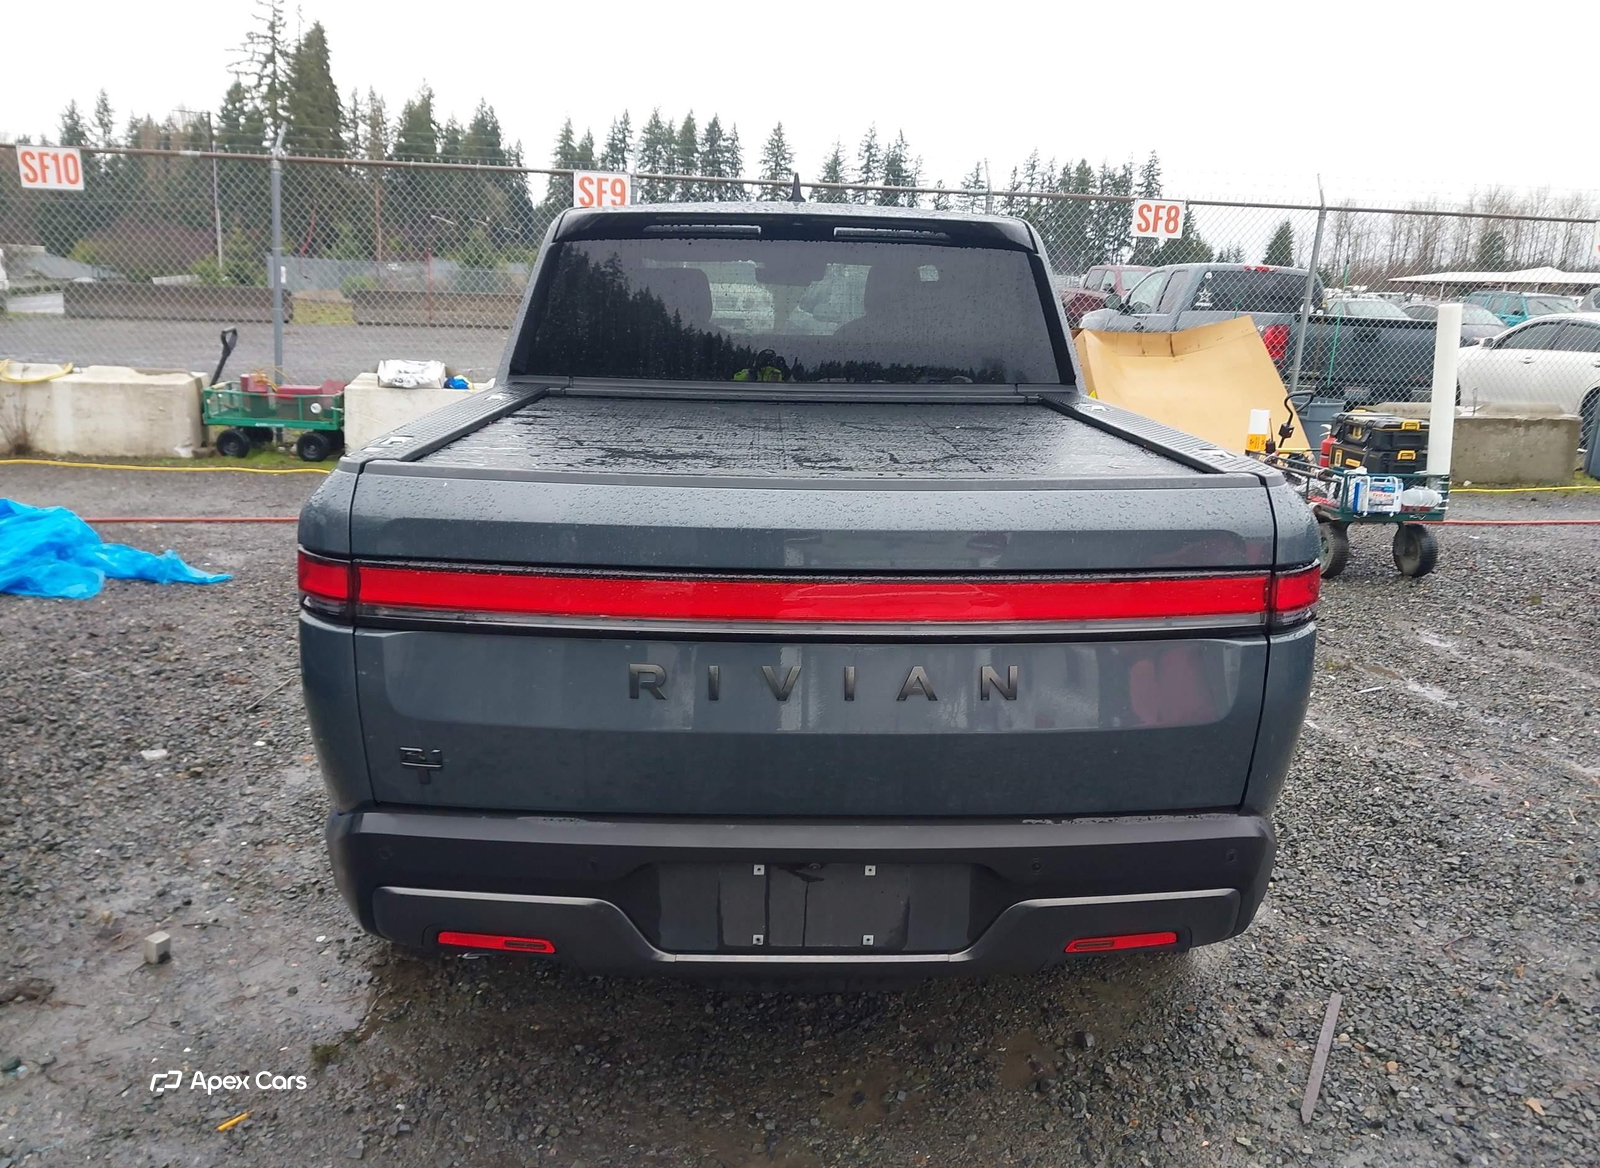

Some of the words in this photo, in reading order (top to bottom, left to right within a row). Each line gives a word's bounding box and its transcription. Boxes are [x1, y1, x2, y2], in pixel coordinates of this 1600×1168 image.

[20, 150, 80, 185] SF10
[578, 176, 626, 207] SF9
[1136, 203, 1180, 234] SF8
[628, 663, 1018, 701] RIVIAN
